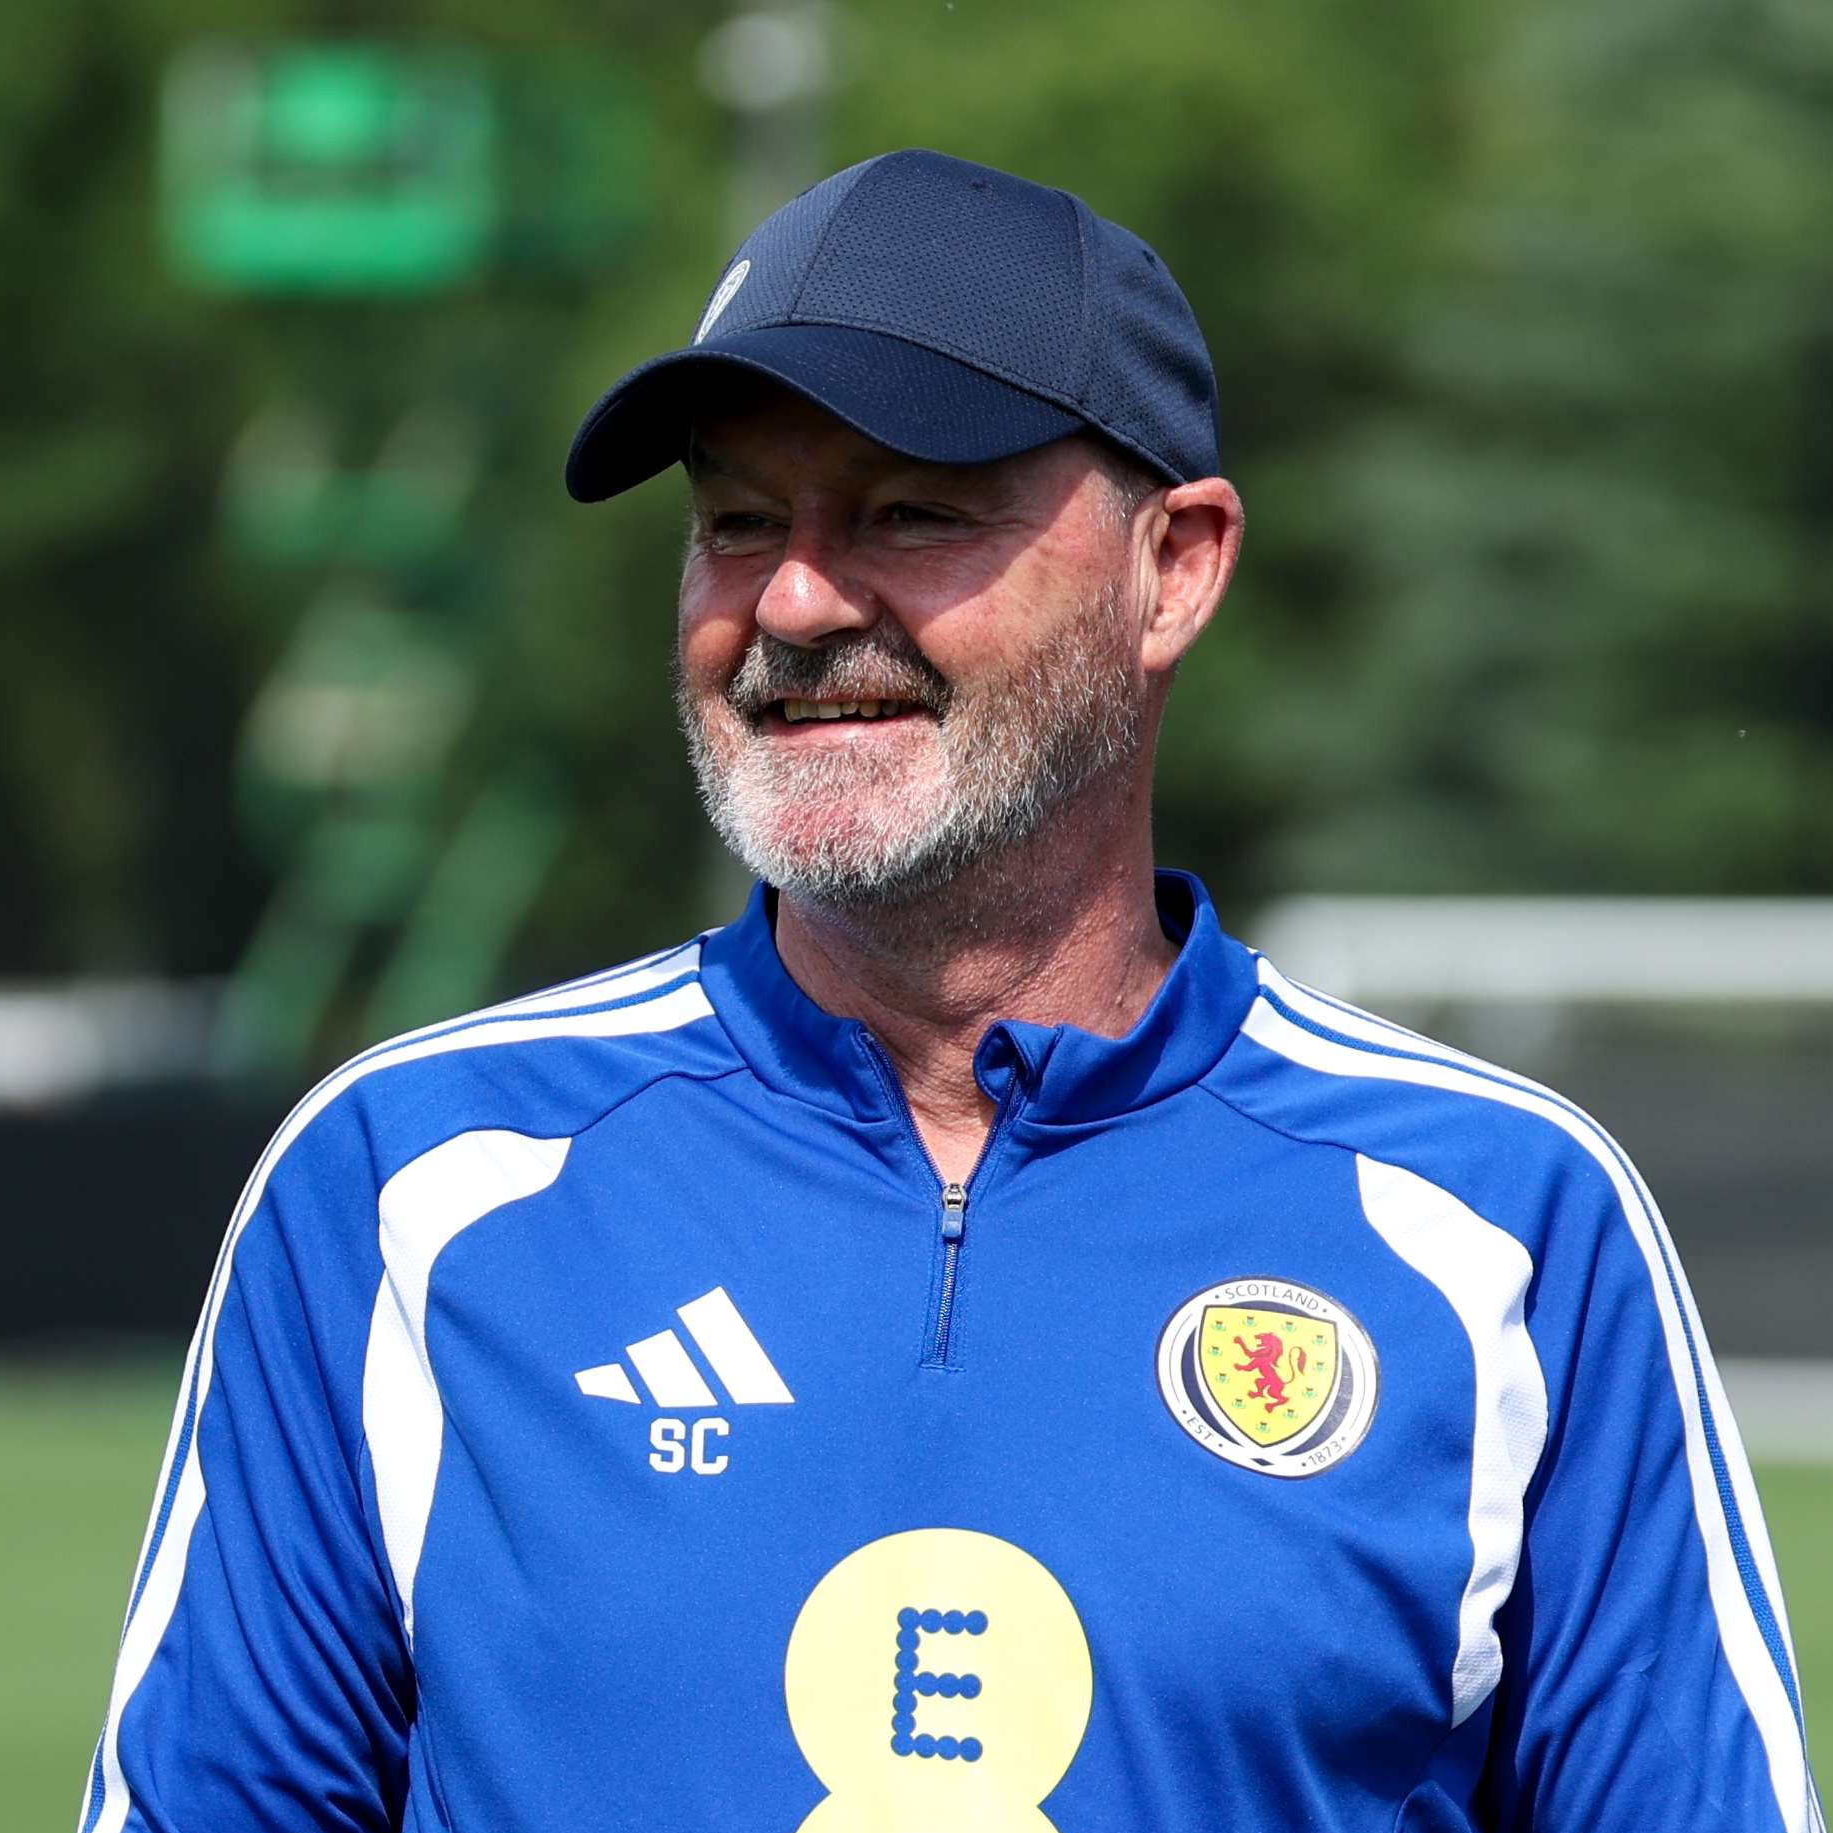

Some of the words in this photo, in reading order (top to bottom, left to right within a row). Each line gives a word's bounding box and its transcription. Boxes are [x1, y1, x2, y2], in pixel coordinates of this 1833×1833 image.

[1225, 1283, 1320, 1312] SCOTLAND
[1186, 1416, 1214, 1442] EST
[648, 1417, 730, 1476] SC
[1308, 1440, 1344, 1467] 1873
